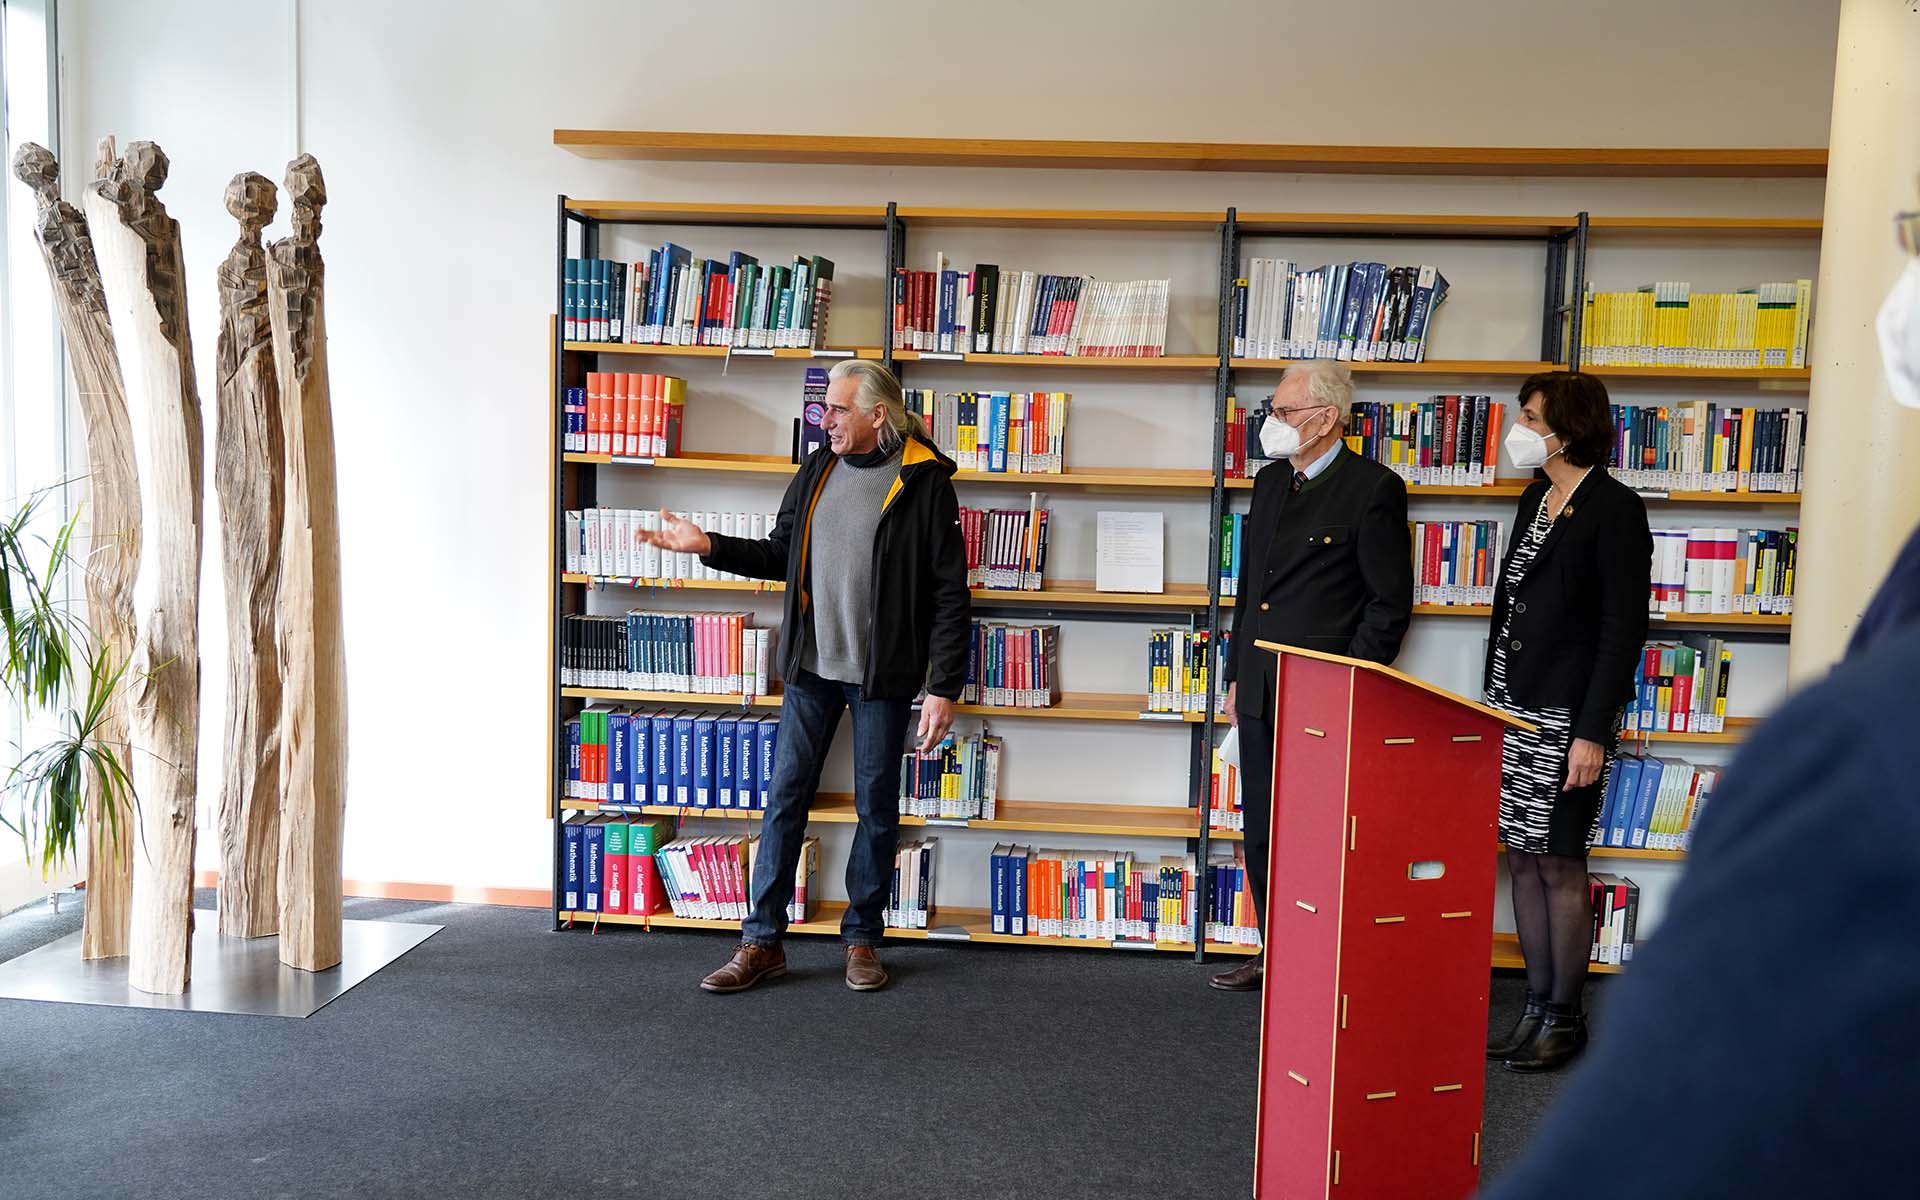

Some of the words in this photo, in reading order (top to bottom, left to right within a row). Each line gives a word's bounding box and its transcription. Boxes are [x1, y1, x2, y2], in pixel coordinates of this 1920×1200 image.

[1412, 290, 1425, 329] CALCULUS
[998, 403, 1007, 450] MATHEMATIK
[1446, 413, 1454, 443] CALCULUS
[1473, 413, 1486, 458] CALCULUS
[637, 733, 645, 774] Mathematik
[659, 734, 667, 775] Mathematik
[680, 735, 688, 776] Mathematik
[722, 737, 730, 778] Mathematik
[742, 739, 750, 780] Mathematik
[569, 842, 577, 882] Mathematik
[590, 843, 598, 883] Mathematik
